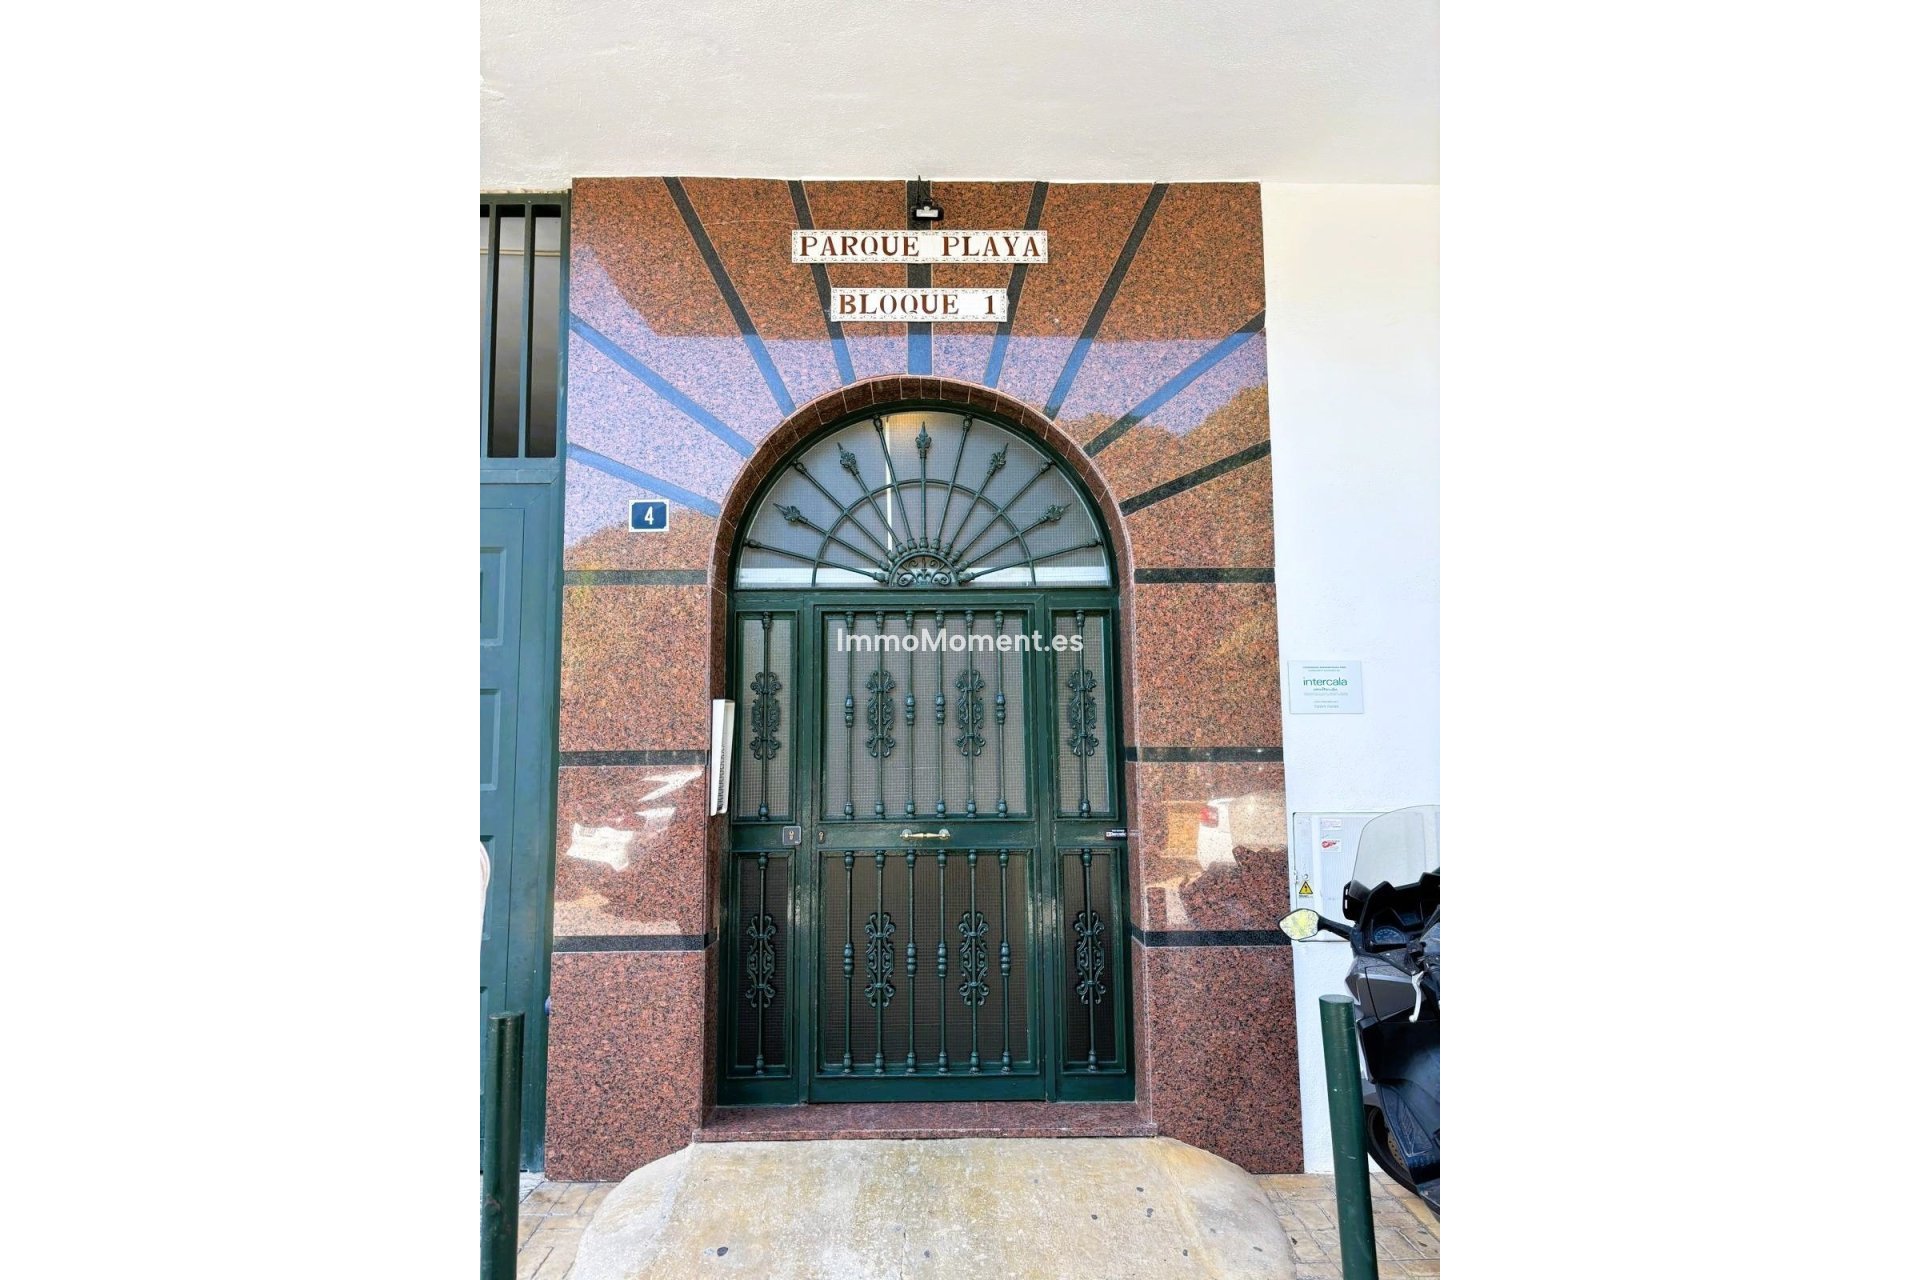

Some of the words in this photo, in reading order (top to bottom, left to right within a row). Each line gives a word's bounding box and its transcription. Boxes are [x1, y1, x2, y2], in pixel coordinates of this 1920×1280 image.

[800, 235, 920, 257] PARQUE
[942, 236, 1041, 257] PLAYA
[839, 294, 959, 315] BLOQUE
[984, 295, 997, 315] 1
[644, 506, 655, 526] 4
[1303, 677, 1348, 687] intercala
